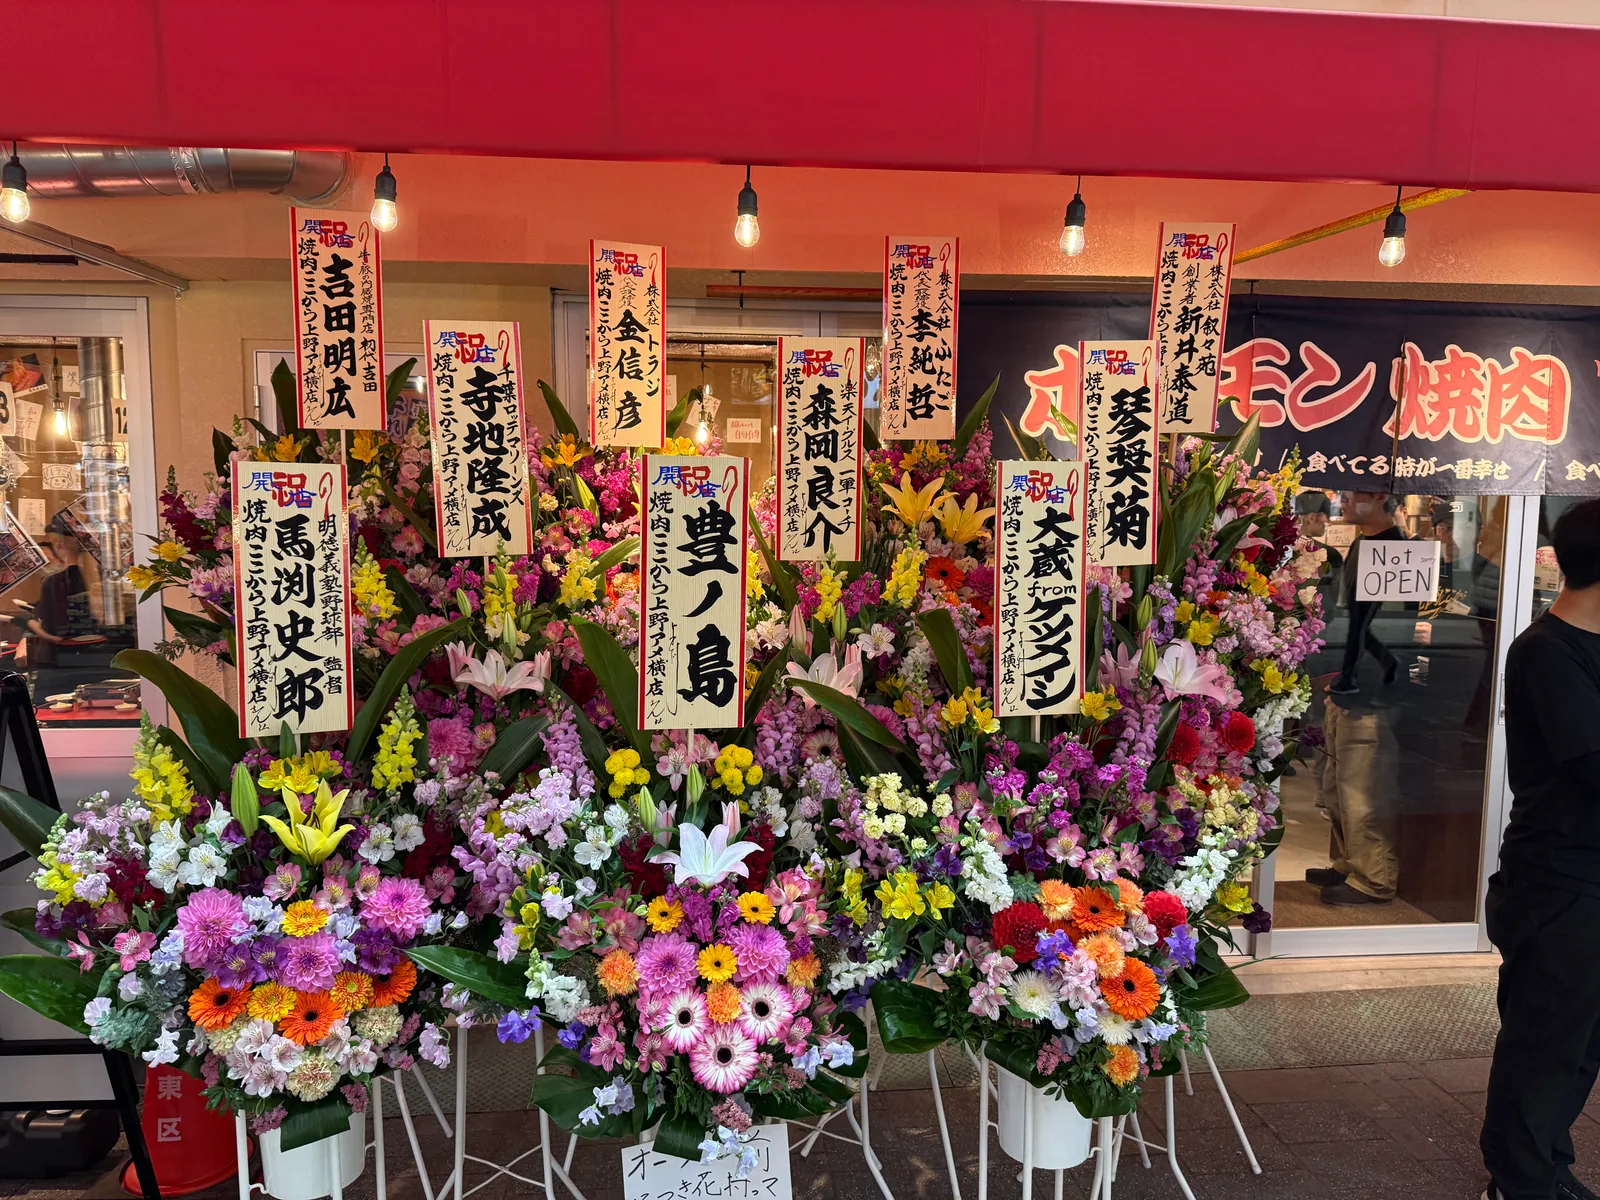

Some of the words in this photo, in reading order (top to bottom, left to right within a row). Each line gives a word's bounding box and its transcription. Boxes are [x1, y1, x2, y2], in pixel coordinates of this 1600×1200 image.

[643, 284, 661, 326] 株式会社
[935, 271, 953, 331] 株式会社
[1179, 262, 1200, 306] 創業者
[1203, 264, 1225, 312] 株式会社
[319, 253, 357, 419] 吉田明広
[359, 337, 378, 392] 初代吉田
[612, 309, 650, 431] 金信彦
[646, 334, 660, 397] トラジ
[906, 309, 939, 421] 李純哲
[1165, 305, 1205, 425] 新井泰道
[1194, 315, 1221, 377] 叙々苑
[934, 338, 952, 411] ふたご
[459, 366, 512, 542] 寺地隆成
[497, 362, 525, 506] 千葉ロッテマリーンズ
[840, 379, 858, 462] 楽天イーグルス
[802, 383, 845, 554] 森岡良介
[837, 469, 856, 534] 一軍コーチ
[1104, 385, 1153, 551] 琴奨菊
[1307, 450, 1512, 482] 食べてる時が一番幸せ
[1024, 506, 1080, 581] 大蔵
[1372, 545, 1412, 566] Not
[314, 514, 344, 648] 明徳義塾野球部
[676, 500, 739, 708] 豊ノ島
[1027, 581, 1077, 597] from
[1364, 567, 1431, 596] OPEN
[323, 656, 344, 695] 監督
[1023, 596, 1077, 711] ケツメイシ
